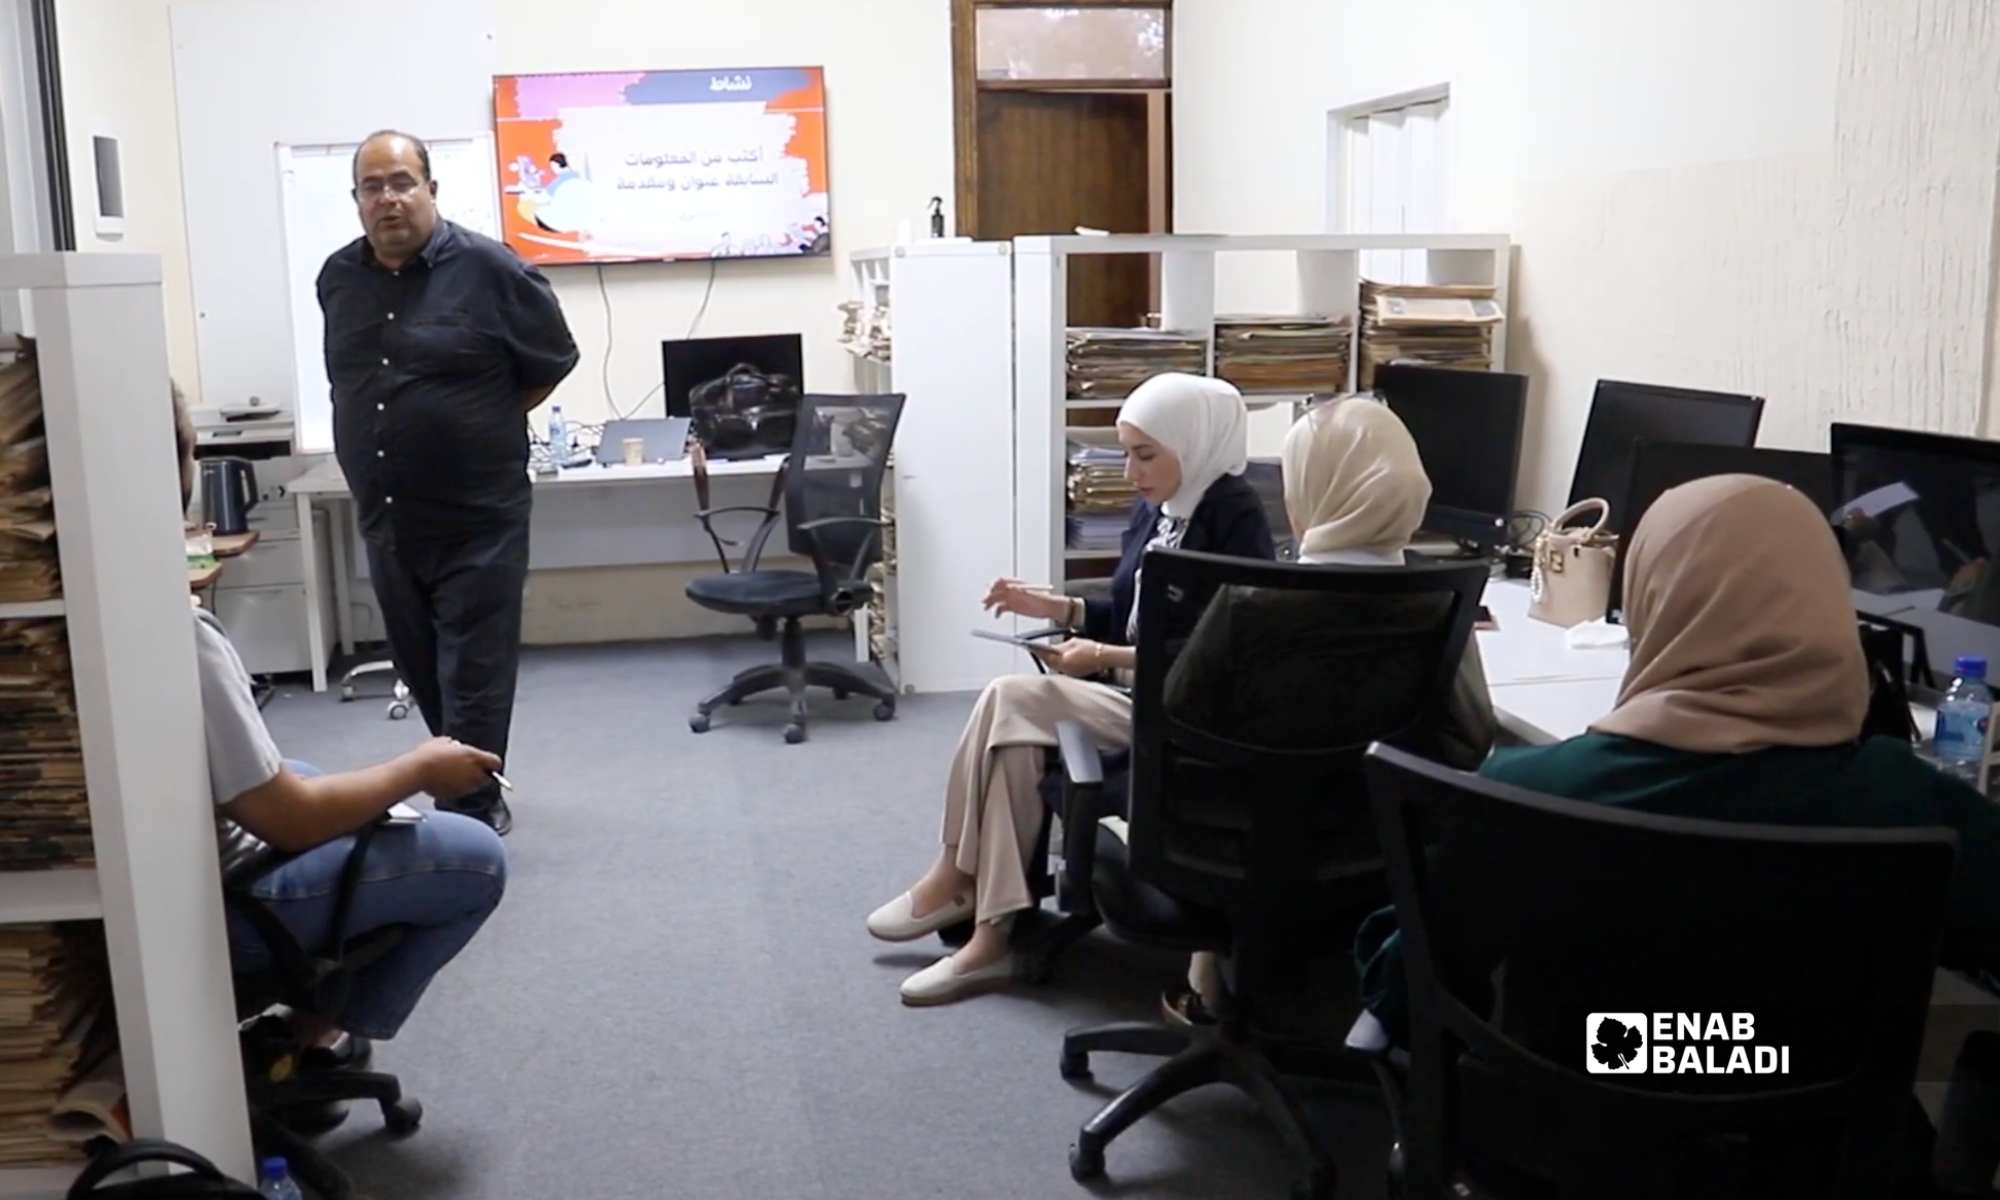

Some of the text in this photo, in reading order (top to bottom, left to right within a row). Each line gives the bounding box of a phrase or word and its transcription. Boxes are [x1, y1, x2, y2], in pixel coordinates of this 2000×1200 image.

[709, 75, 752, 91] نشاط
[626, 150, 696, 168] المعلومات
[702, 151, 722, 167] من
[617, 172, 778, 191] السابقة عنوان ومقدمة
